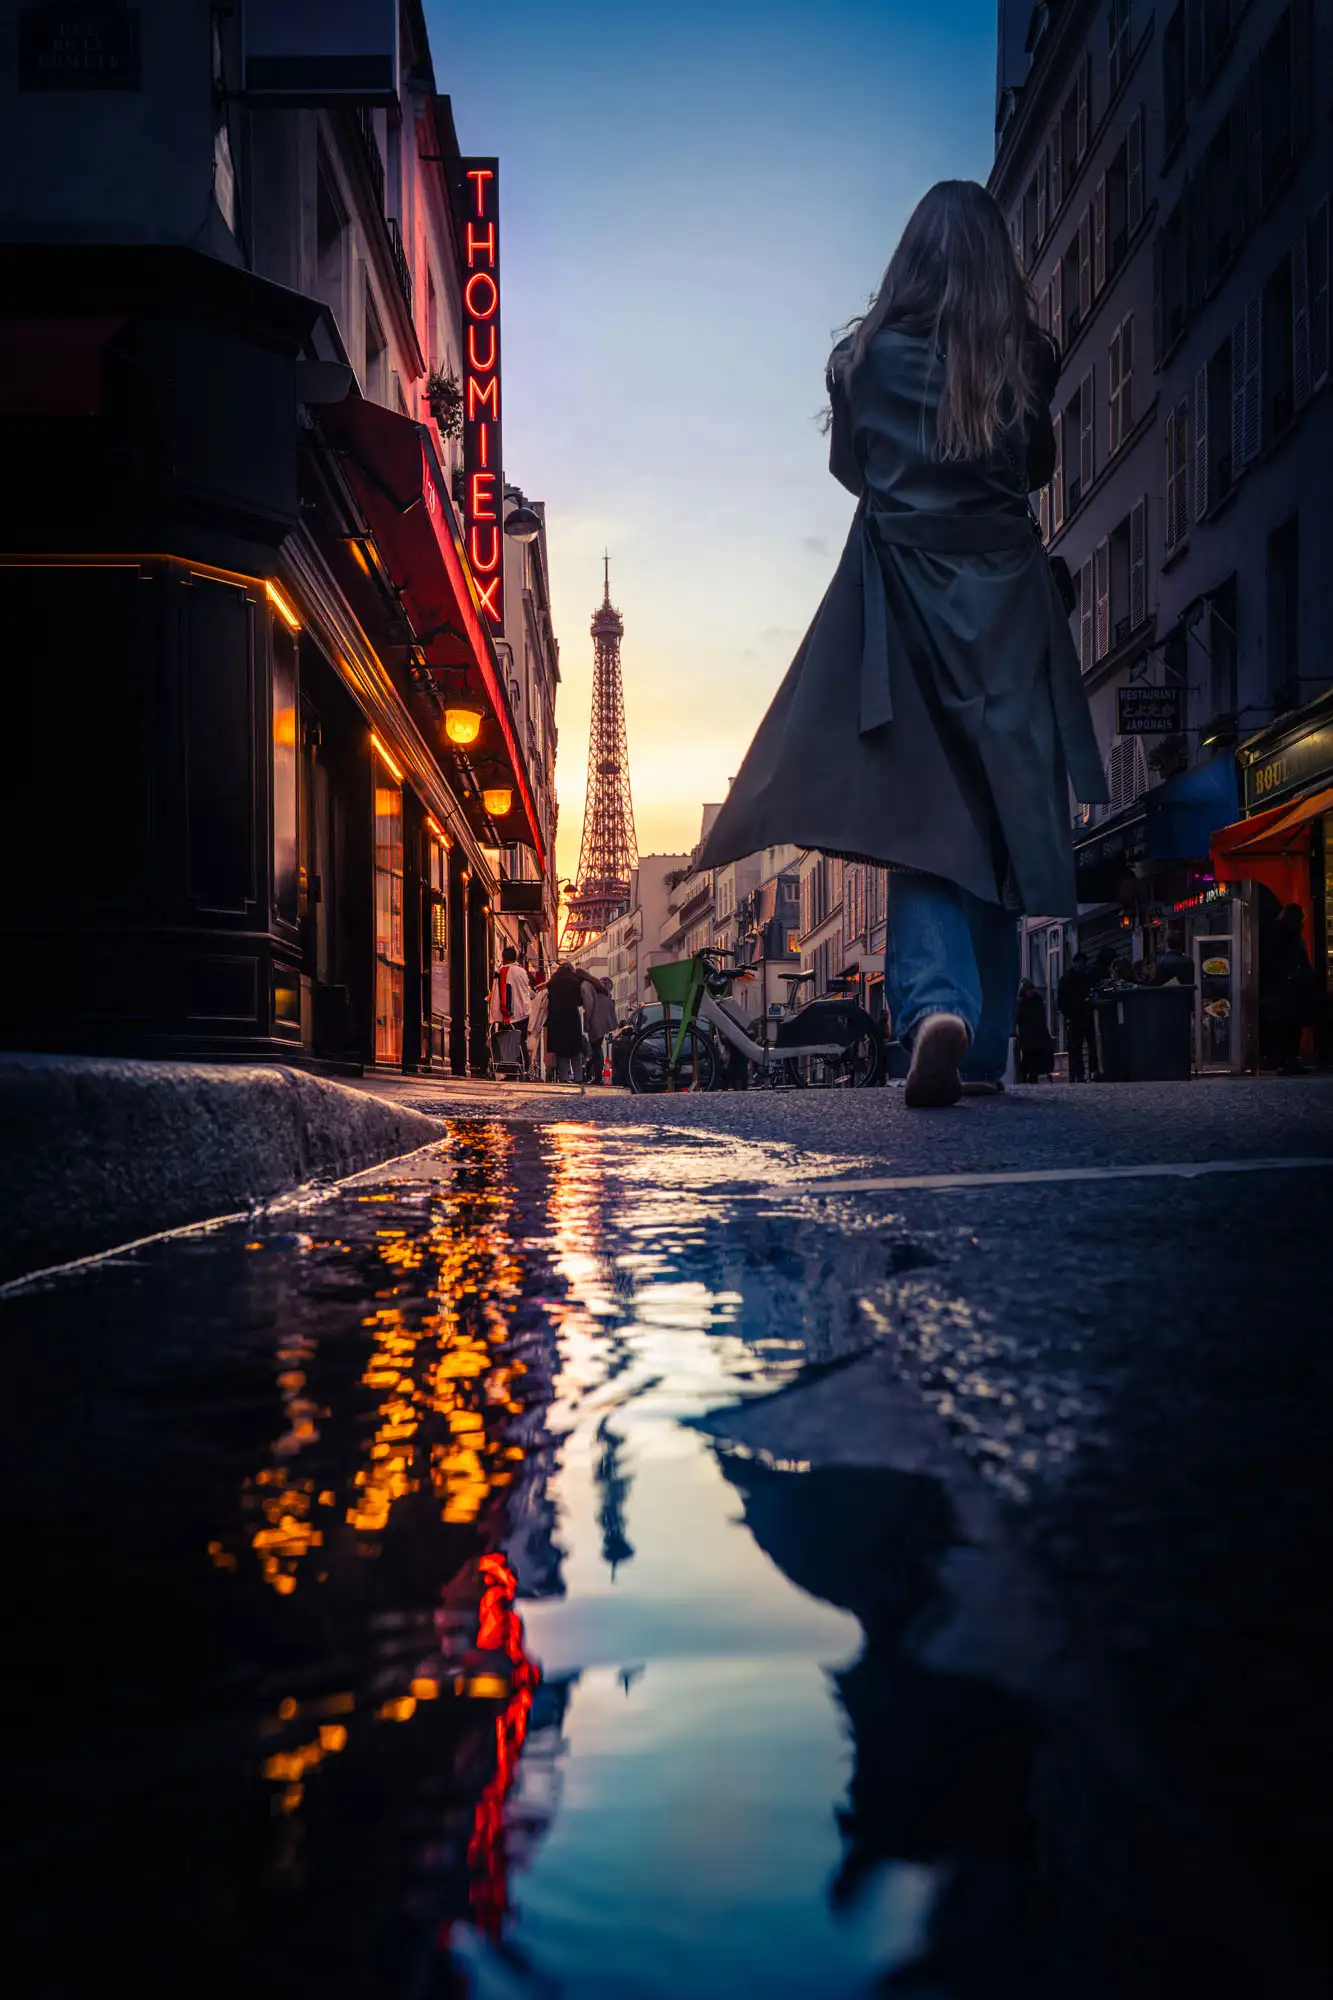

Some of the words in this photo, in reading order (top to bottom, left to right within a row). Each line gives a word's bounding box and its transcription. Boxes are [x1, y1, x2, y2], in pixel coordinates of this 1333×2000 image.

[464, 169, 501, 622] THOUMIEUX
[1120, 689, 1177, 701] RESTAURANT
[1126, 718, 1173, 732] JAPONAIS
